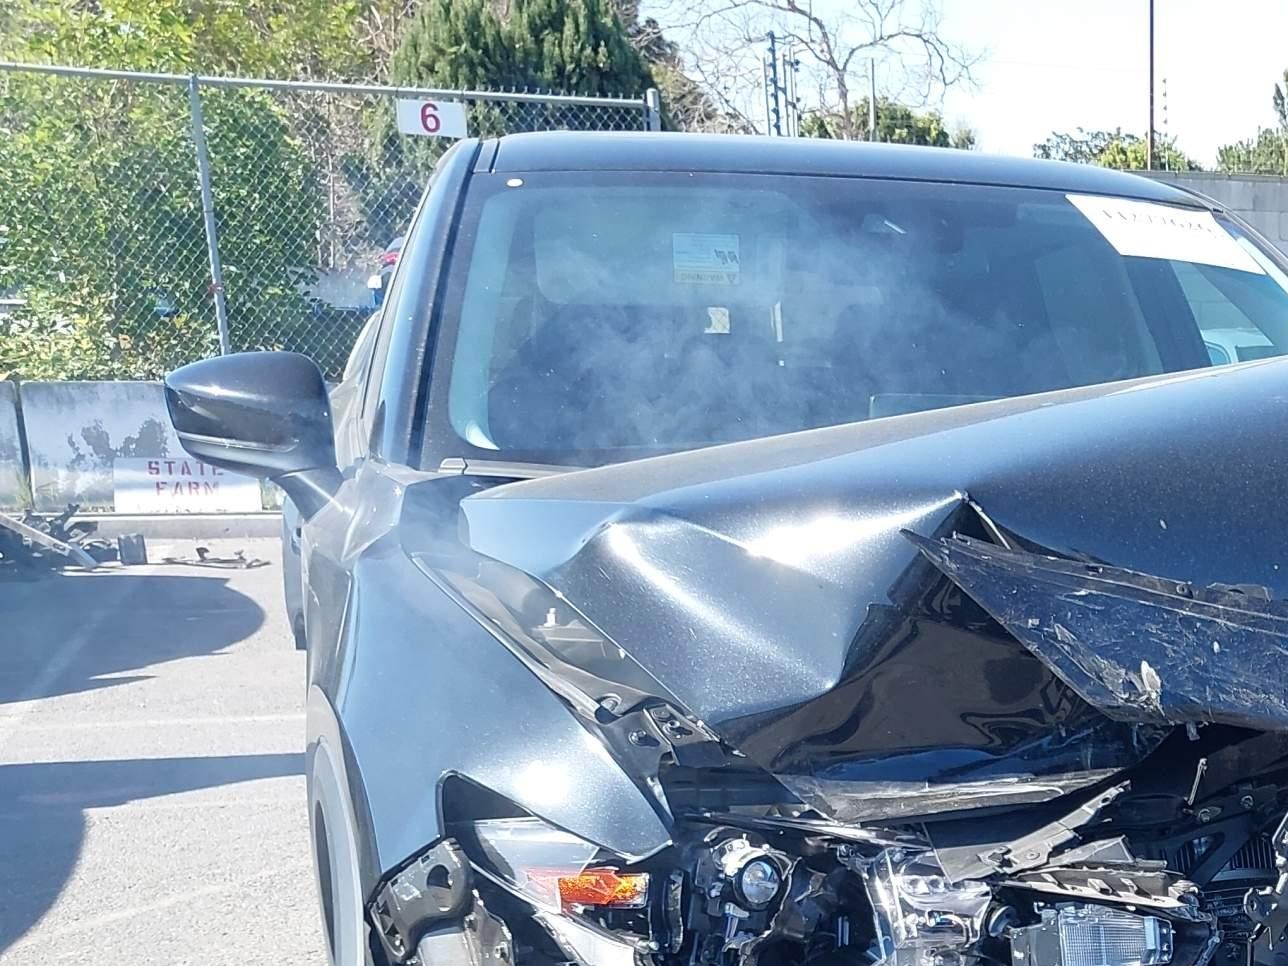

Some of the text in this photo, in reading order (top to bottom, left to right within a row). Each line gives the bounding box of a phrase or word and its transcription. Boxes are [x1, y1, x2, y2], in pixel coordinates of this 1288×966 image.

[421, 103, 440, 133] 6
[147, 461, 224, 476] STATE
[155, 481, 220, 496] FARM
